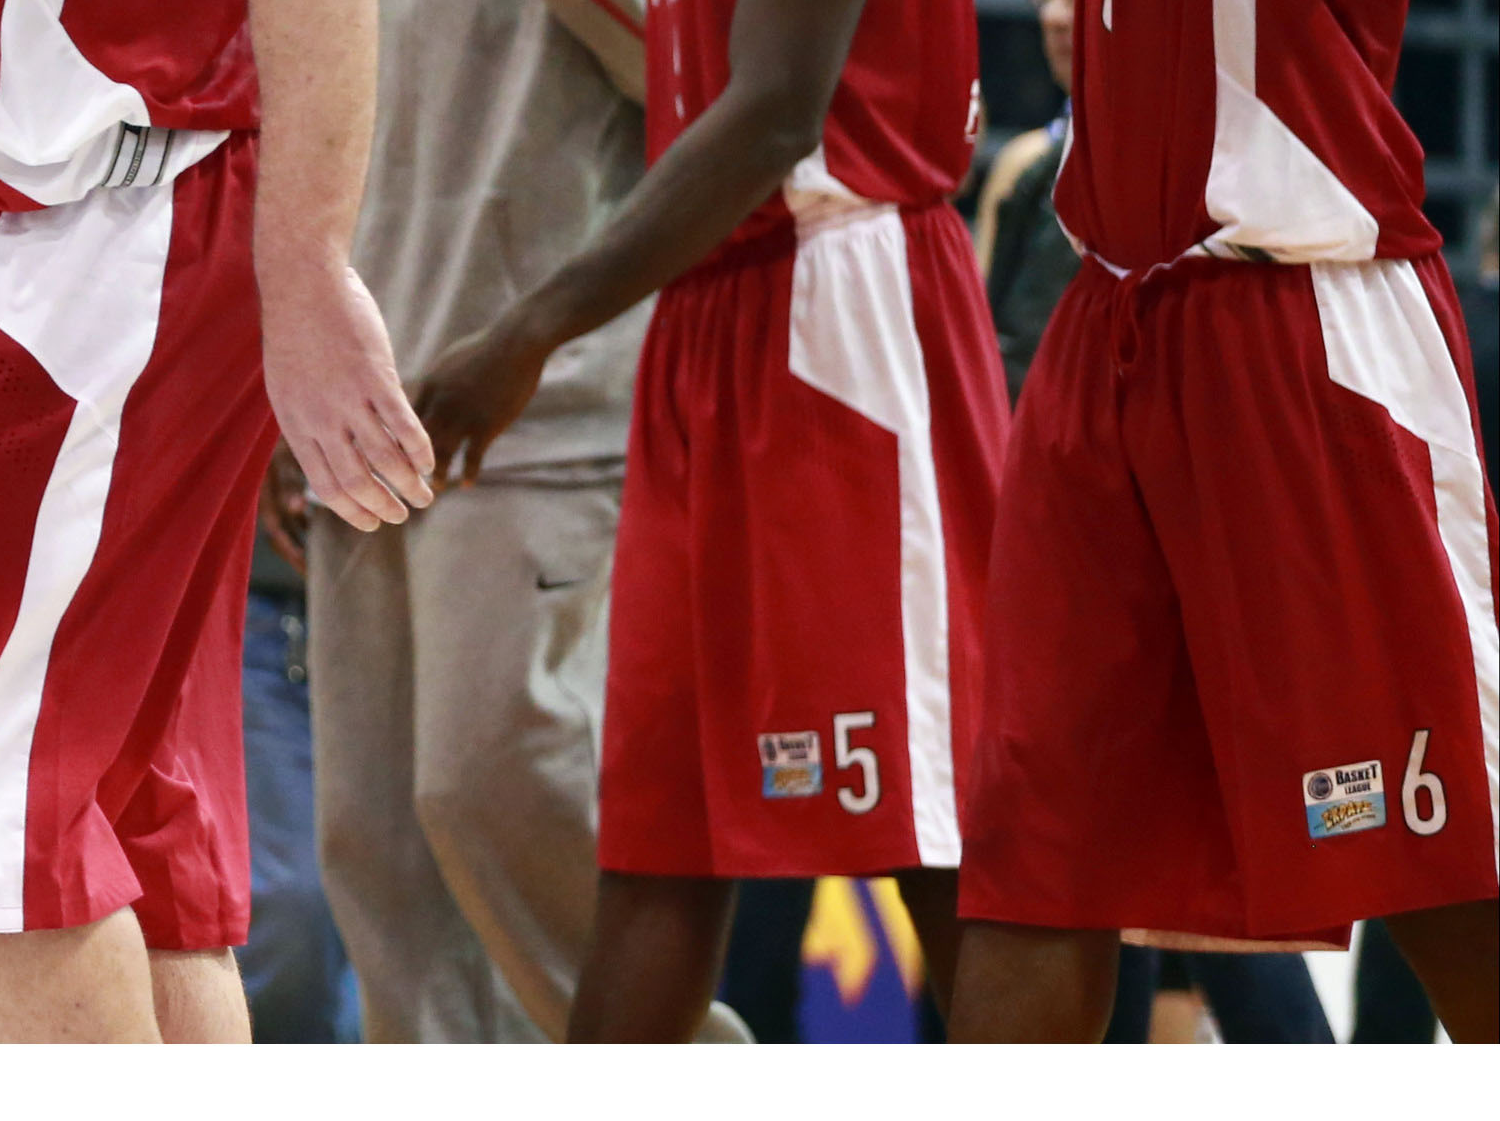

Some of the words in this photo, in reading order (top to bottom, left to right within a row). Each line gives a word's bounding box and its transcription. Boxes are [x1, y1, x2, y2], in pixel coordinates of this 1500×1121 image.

[833, 711, 881, 814] 5
[1335, 764, 1378, 785] BASKET
[1401, 729, 1448, 836] 6
